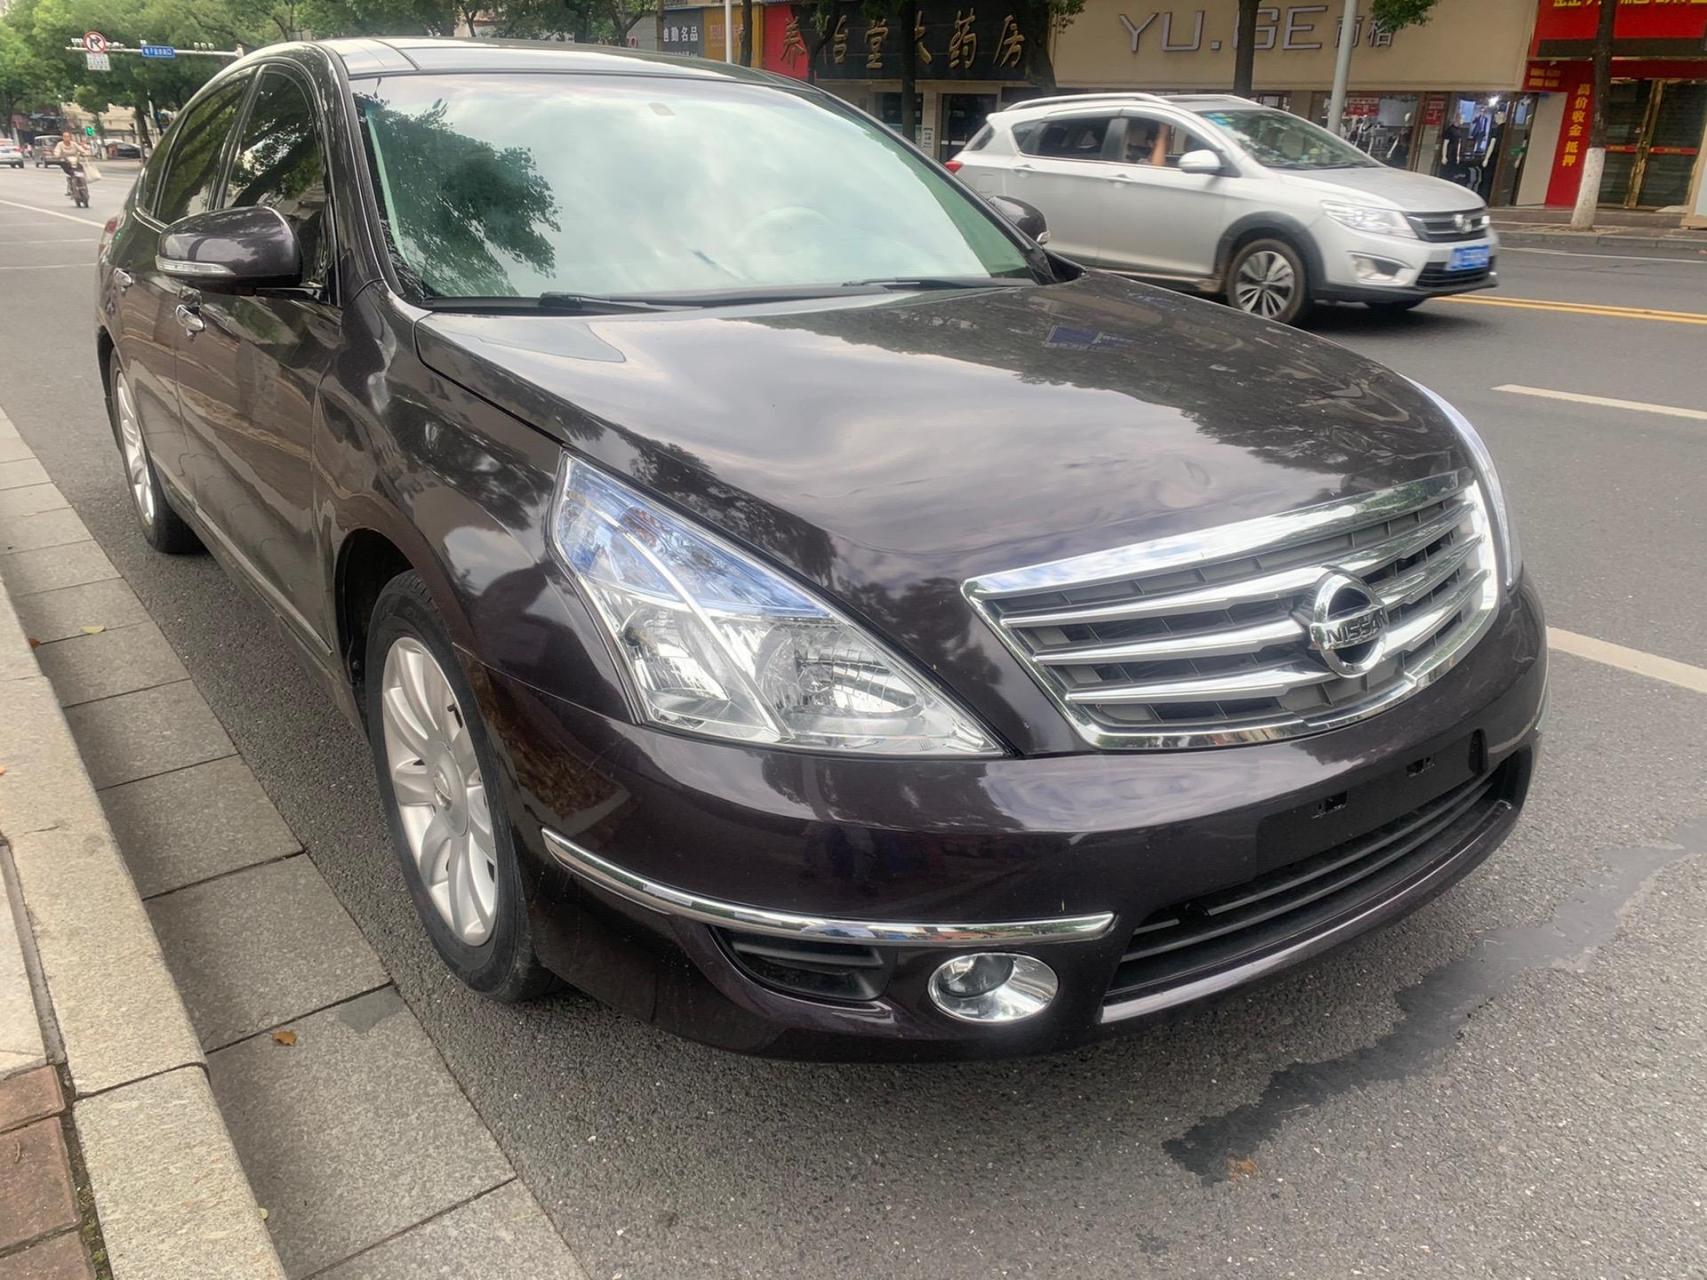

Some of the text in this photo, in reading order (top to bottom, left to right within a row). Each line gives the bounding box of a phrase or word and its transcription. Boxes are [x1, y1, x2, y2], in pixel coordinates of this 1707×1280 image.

[1119, 5, 1328, 52] YU.GE
[1568, 83, 1591, 137] 高价收金
[1326, 607, 1389, 644] NISSAN
